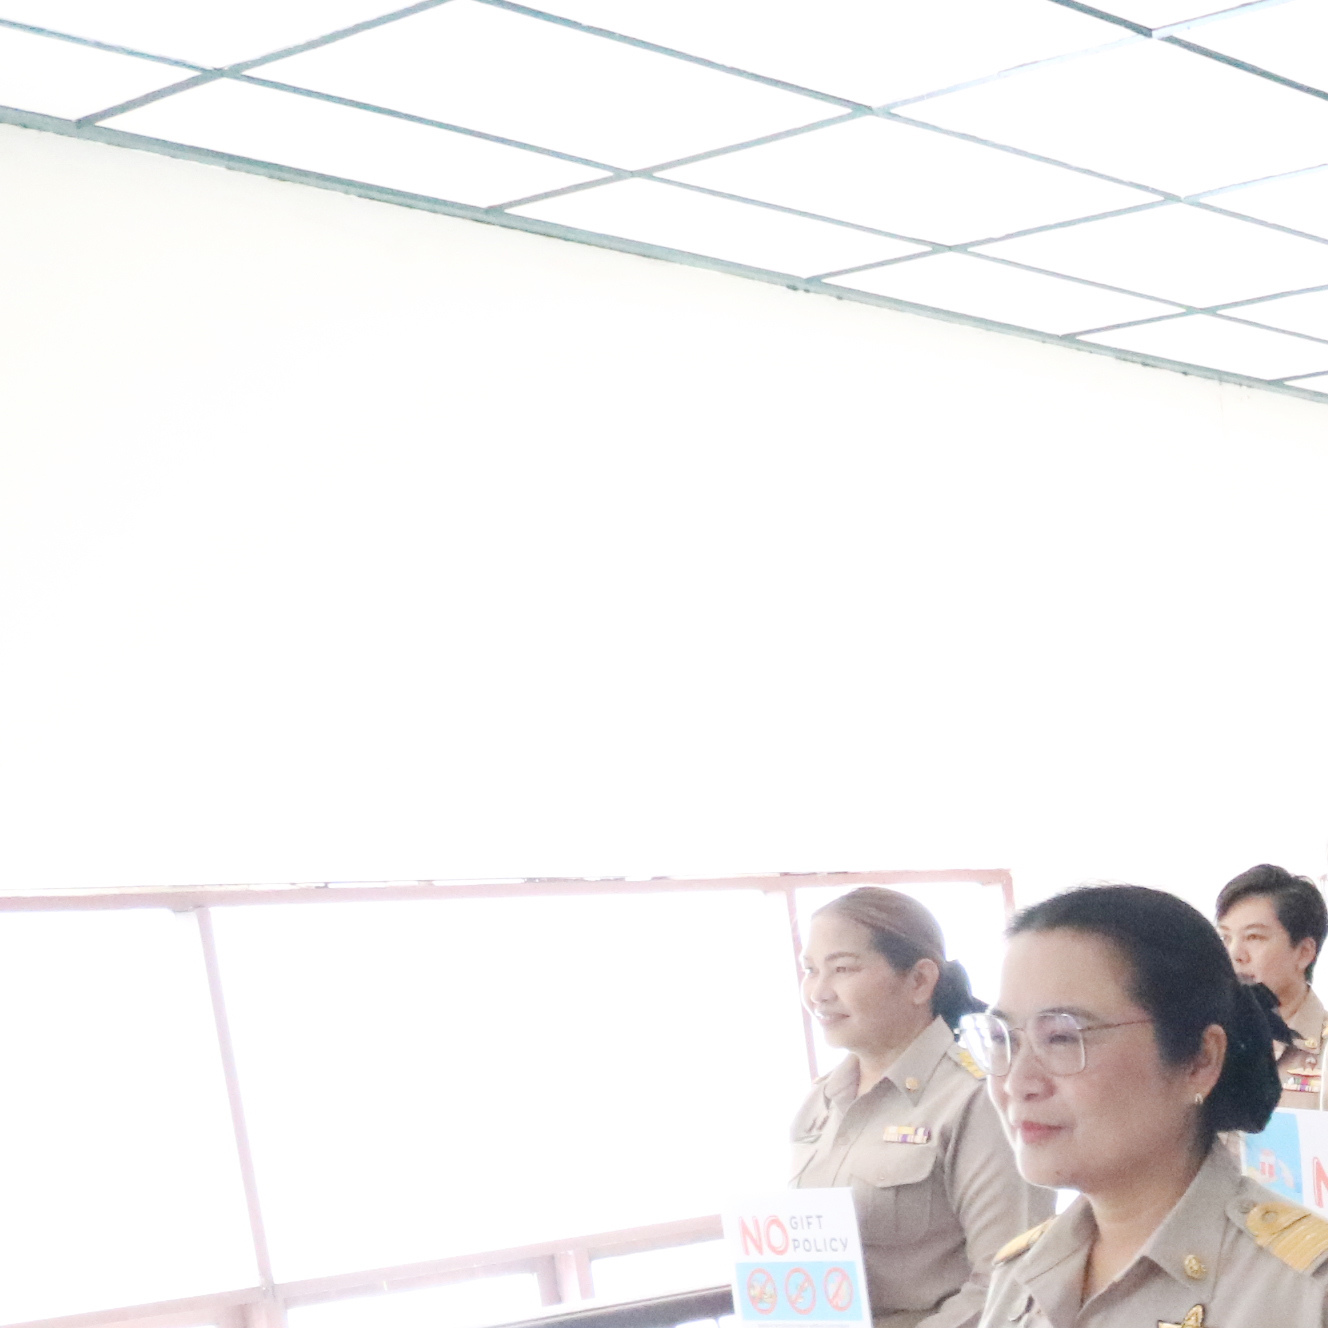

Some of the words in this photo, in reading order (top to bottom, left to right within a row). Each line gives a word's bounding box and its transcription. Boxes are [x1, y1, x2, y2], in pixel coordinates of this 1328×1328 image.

[789, 1214, 824, 1231] GIFT
[738, 1215, 790, 1256] NO
[791, 1237, 848, 1253] POLICY
